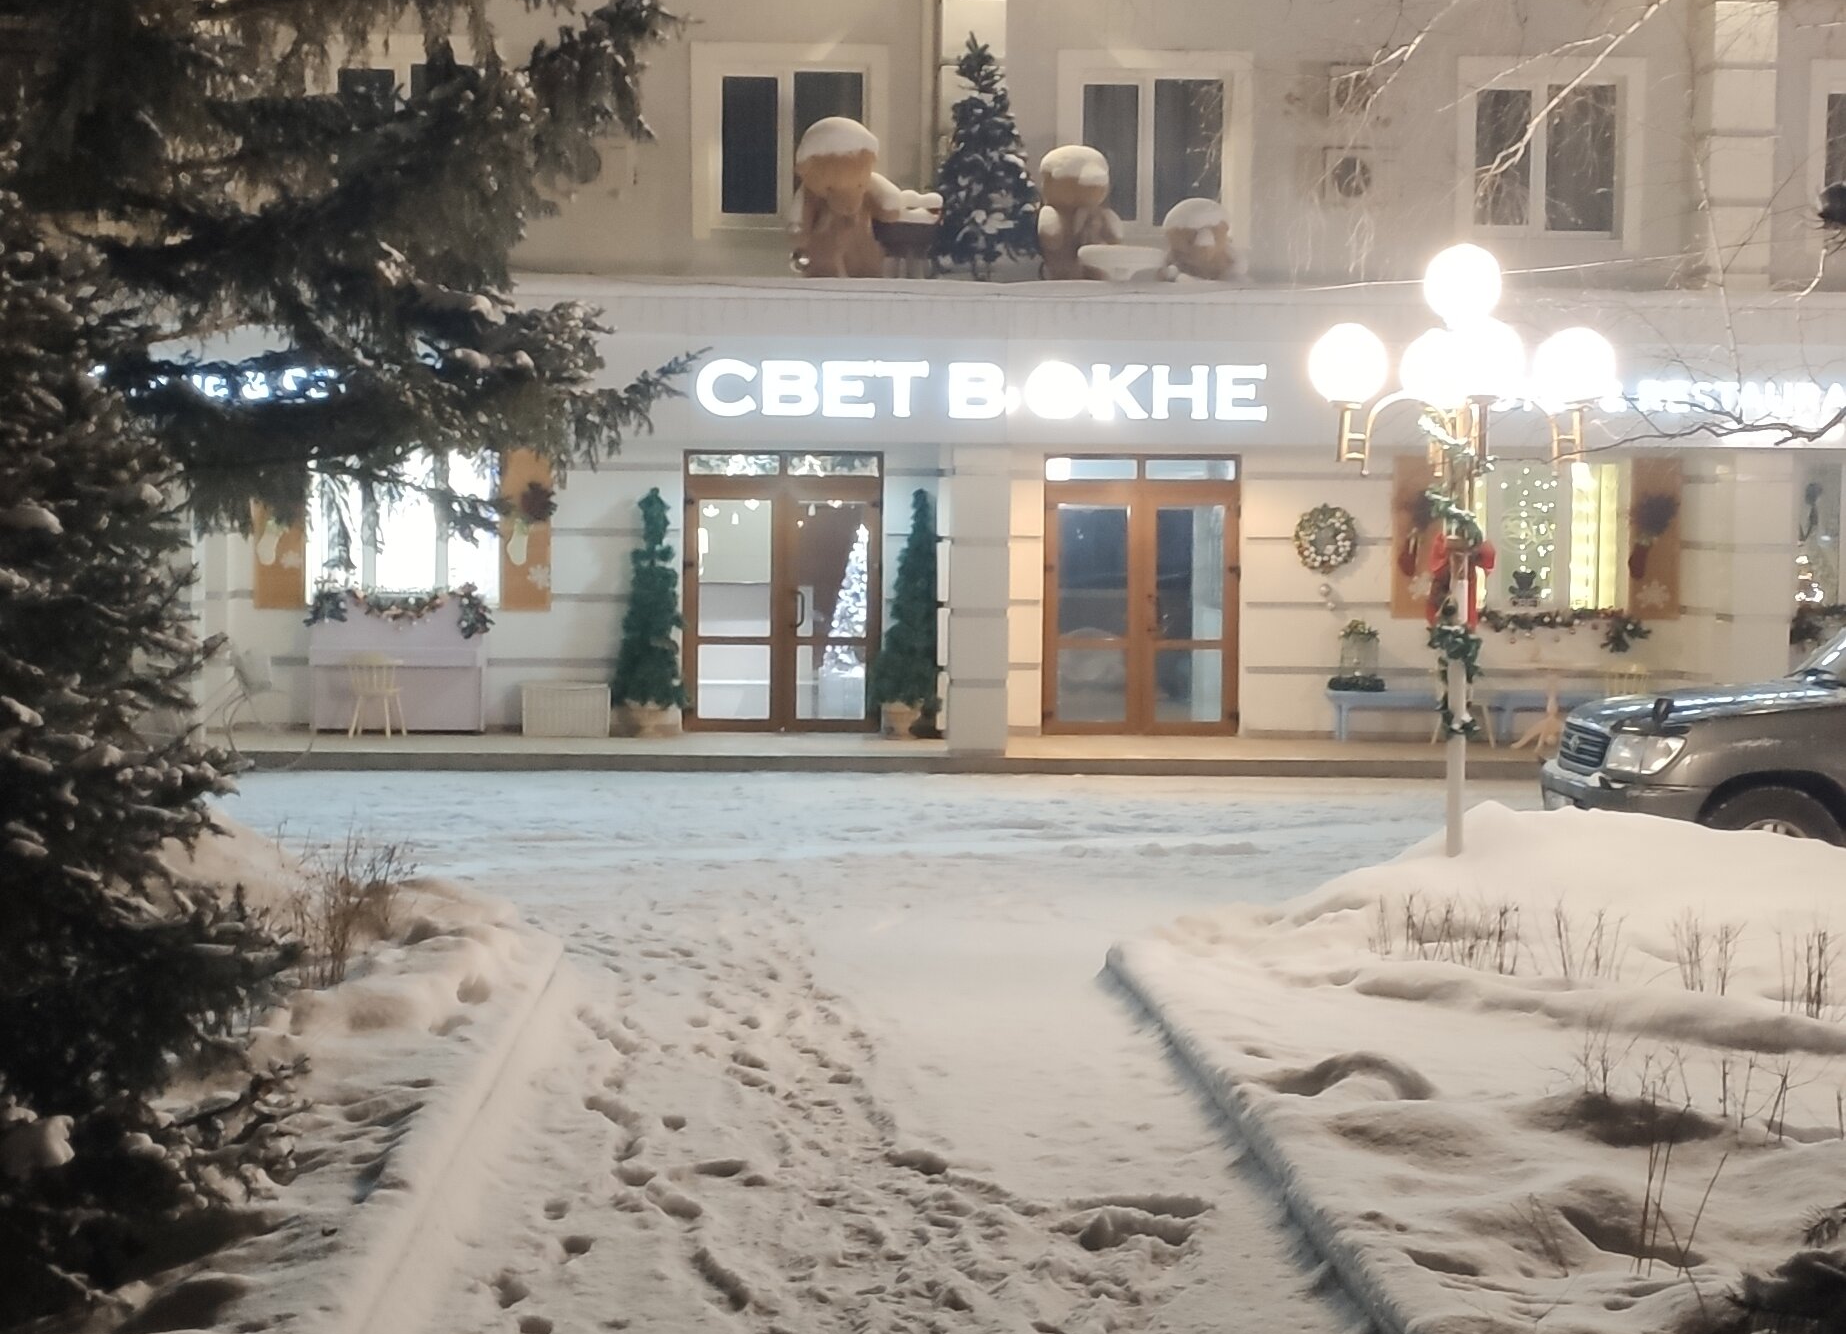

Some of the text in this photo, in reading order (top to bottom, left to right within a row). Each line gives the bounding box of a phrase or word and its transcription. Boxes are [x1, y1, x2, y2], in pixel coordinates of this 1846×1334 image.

[695, 358, 1268, 423] СВЕТ В ОКНЕ
